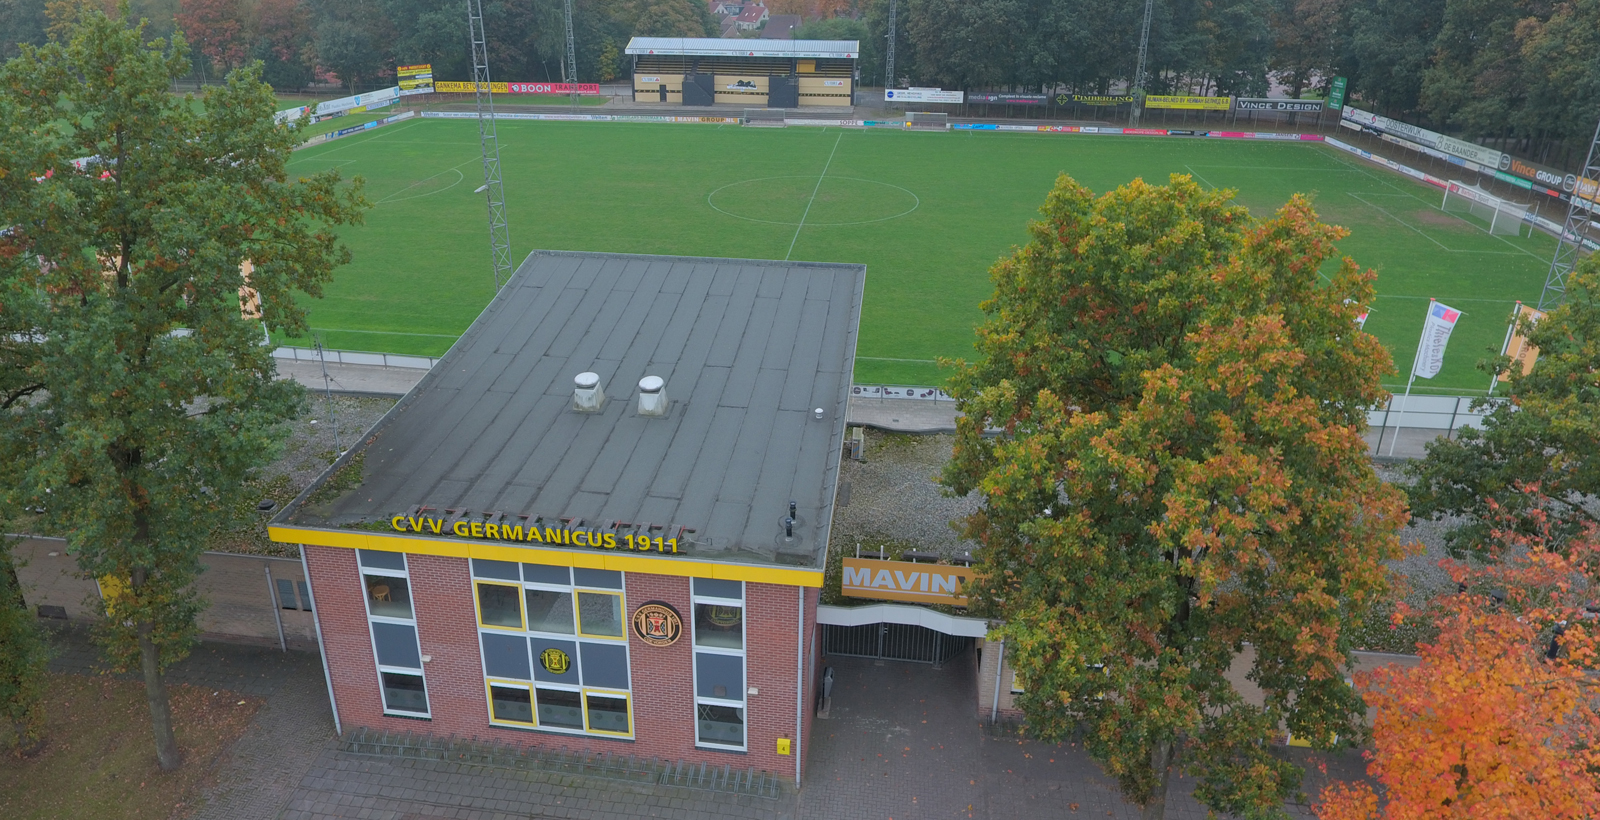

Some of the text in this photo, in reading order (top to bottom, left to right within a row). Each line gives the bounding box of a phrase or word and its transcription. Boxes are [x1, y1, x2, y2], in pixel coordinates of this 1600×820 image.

[463, 82, 508, 90] BETOBOINGEN
[521, 84, 551, 92] BOON
[1278, 102, 1320, 110] DESIGN
[1512, 160, 1536, 178] Vince
[1536, 170, 1562, 186] GROUP
[392, 516, 678, 553] CVV GERMANICUS 1911
[842, 566, 956, 593] MAVIN
